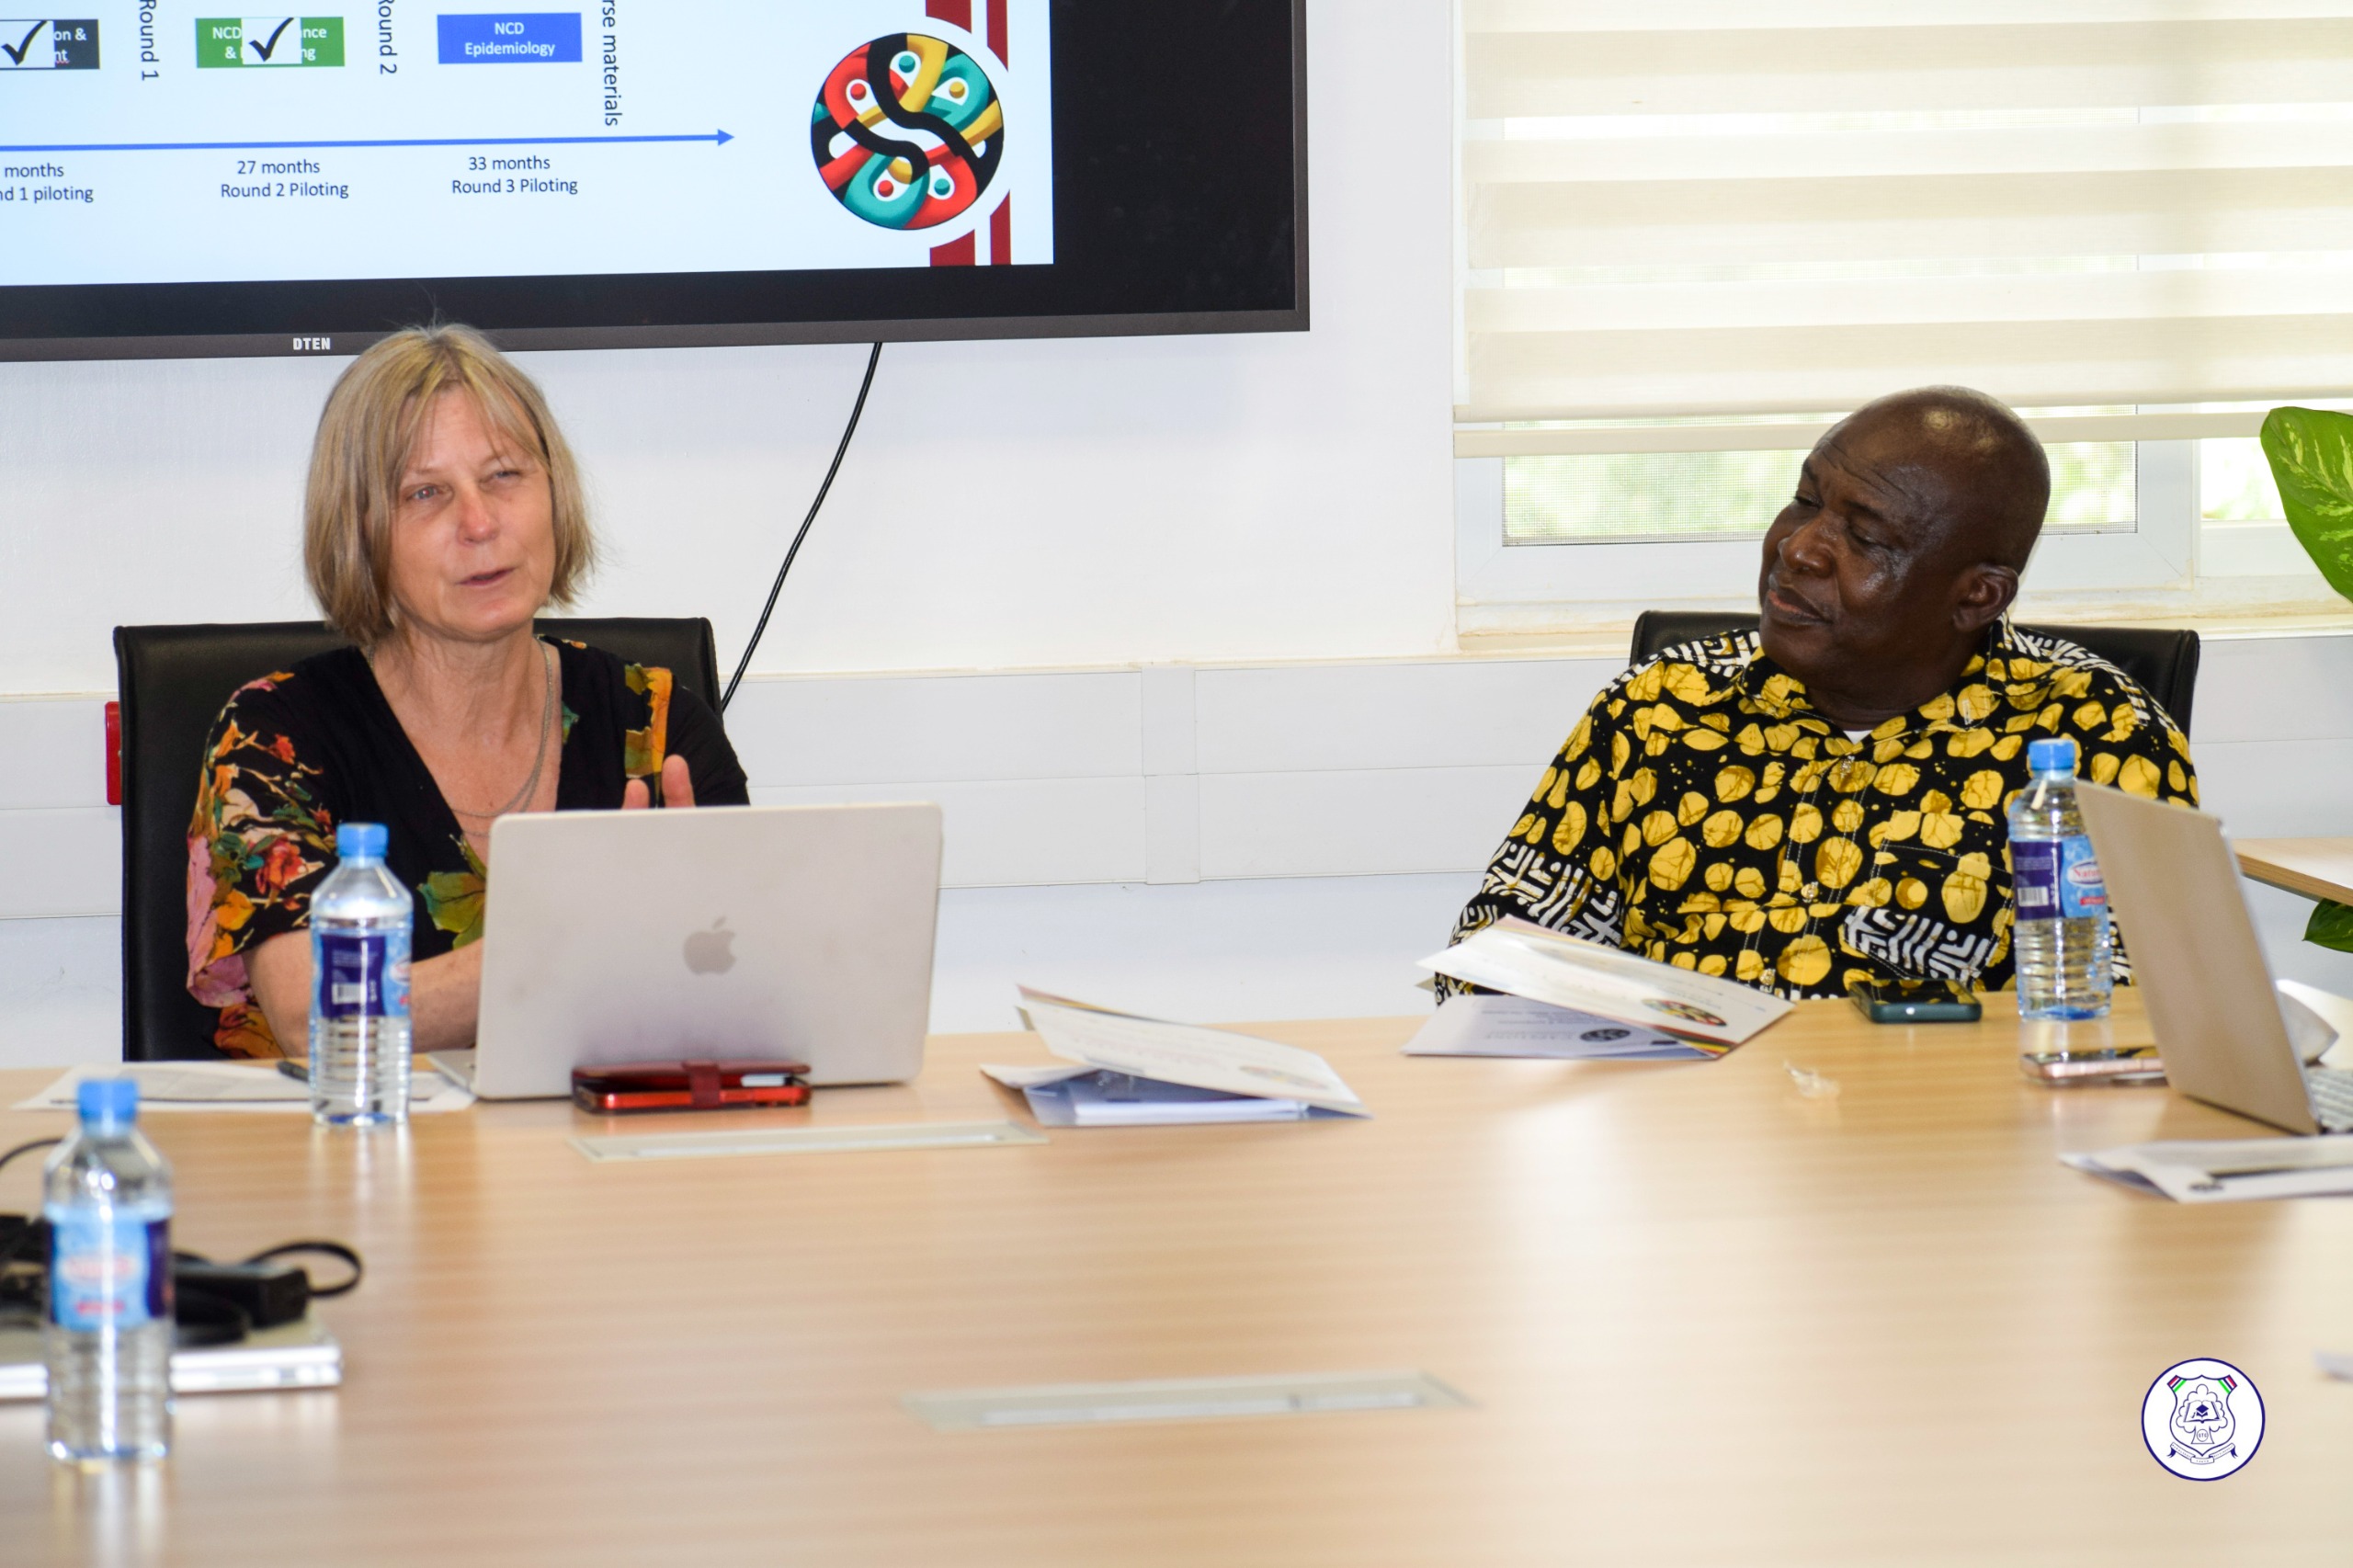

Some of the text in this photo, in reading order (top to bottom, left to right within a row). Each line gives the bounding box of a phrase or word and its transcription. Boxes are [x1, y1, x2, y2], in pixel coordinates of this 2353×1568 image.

[74, 28, 87, 40] &
[212, 27, 327, 39] NCD nce
[494, 22, 525, 35] NCD
[139, 0, 160, 81] Round 1
[224, 46, 237, 59] &
[464, 41, 555, 57] Epidemiology
[380, 63, 397, 74] 2
[603, 35, 622, 126] materials
[5, 163, 64, 177] months
[237, 159, 321, 175] 27 months
[469, 155, 551, 171] 33 months
[221, 181, 349, 199] Round 2 Piloting
[452, 177, 579, 195] Round 3 Piloting
[19, 187, 28, 200] 1
[33, 186, 94, 204] piloting
[292, 337, 331, 350] DTEN
